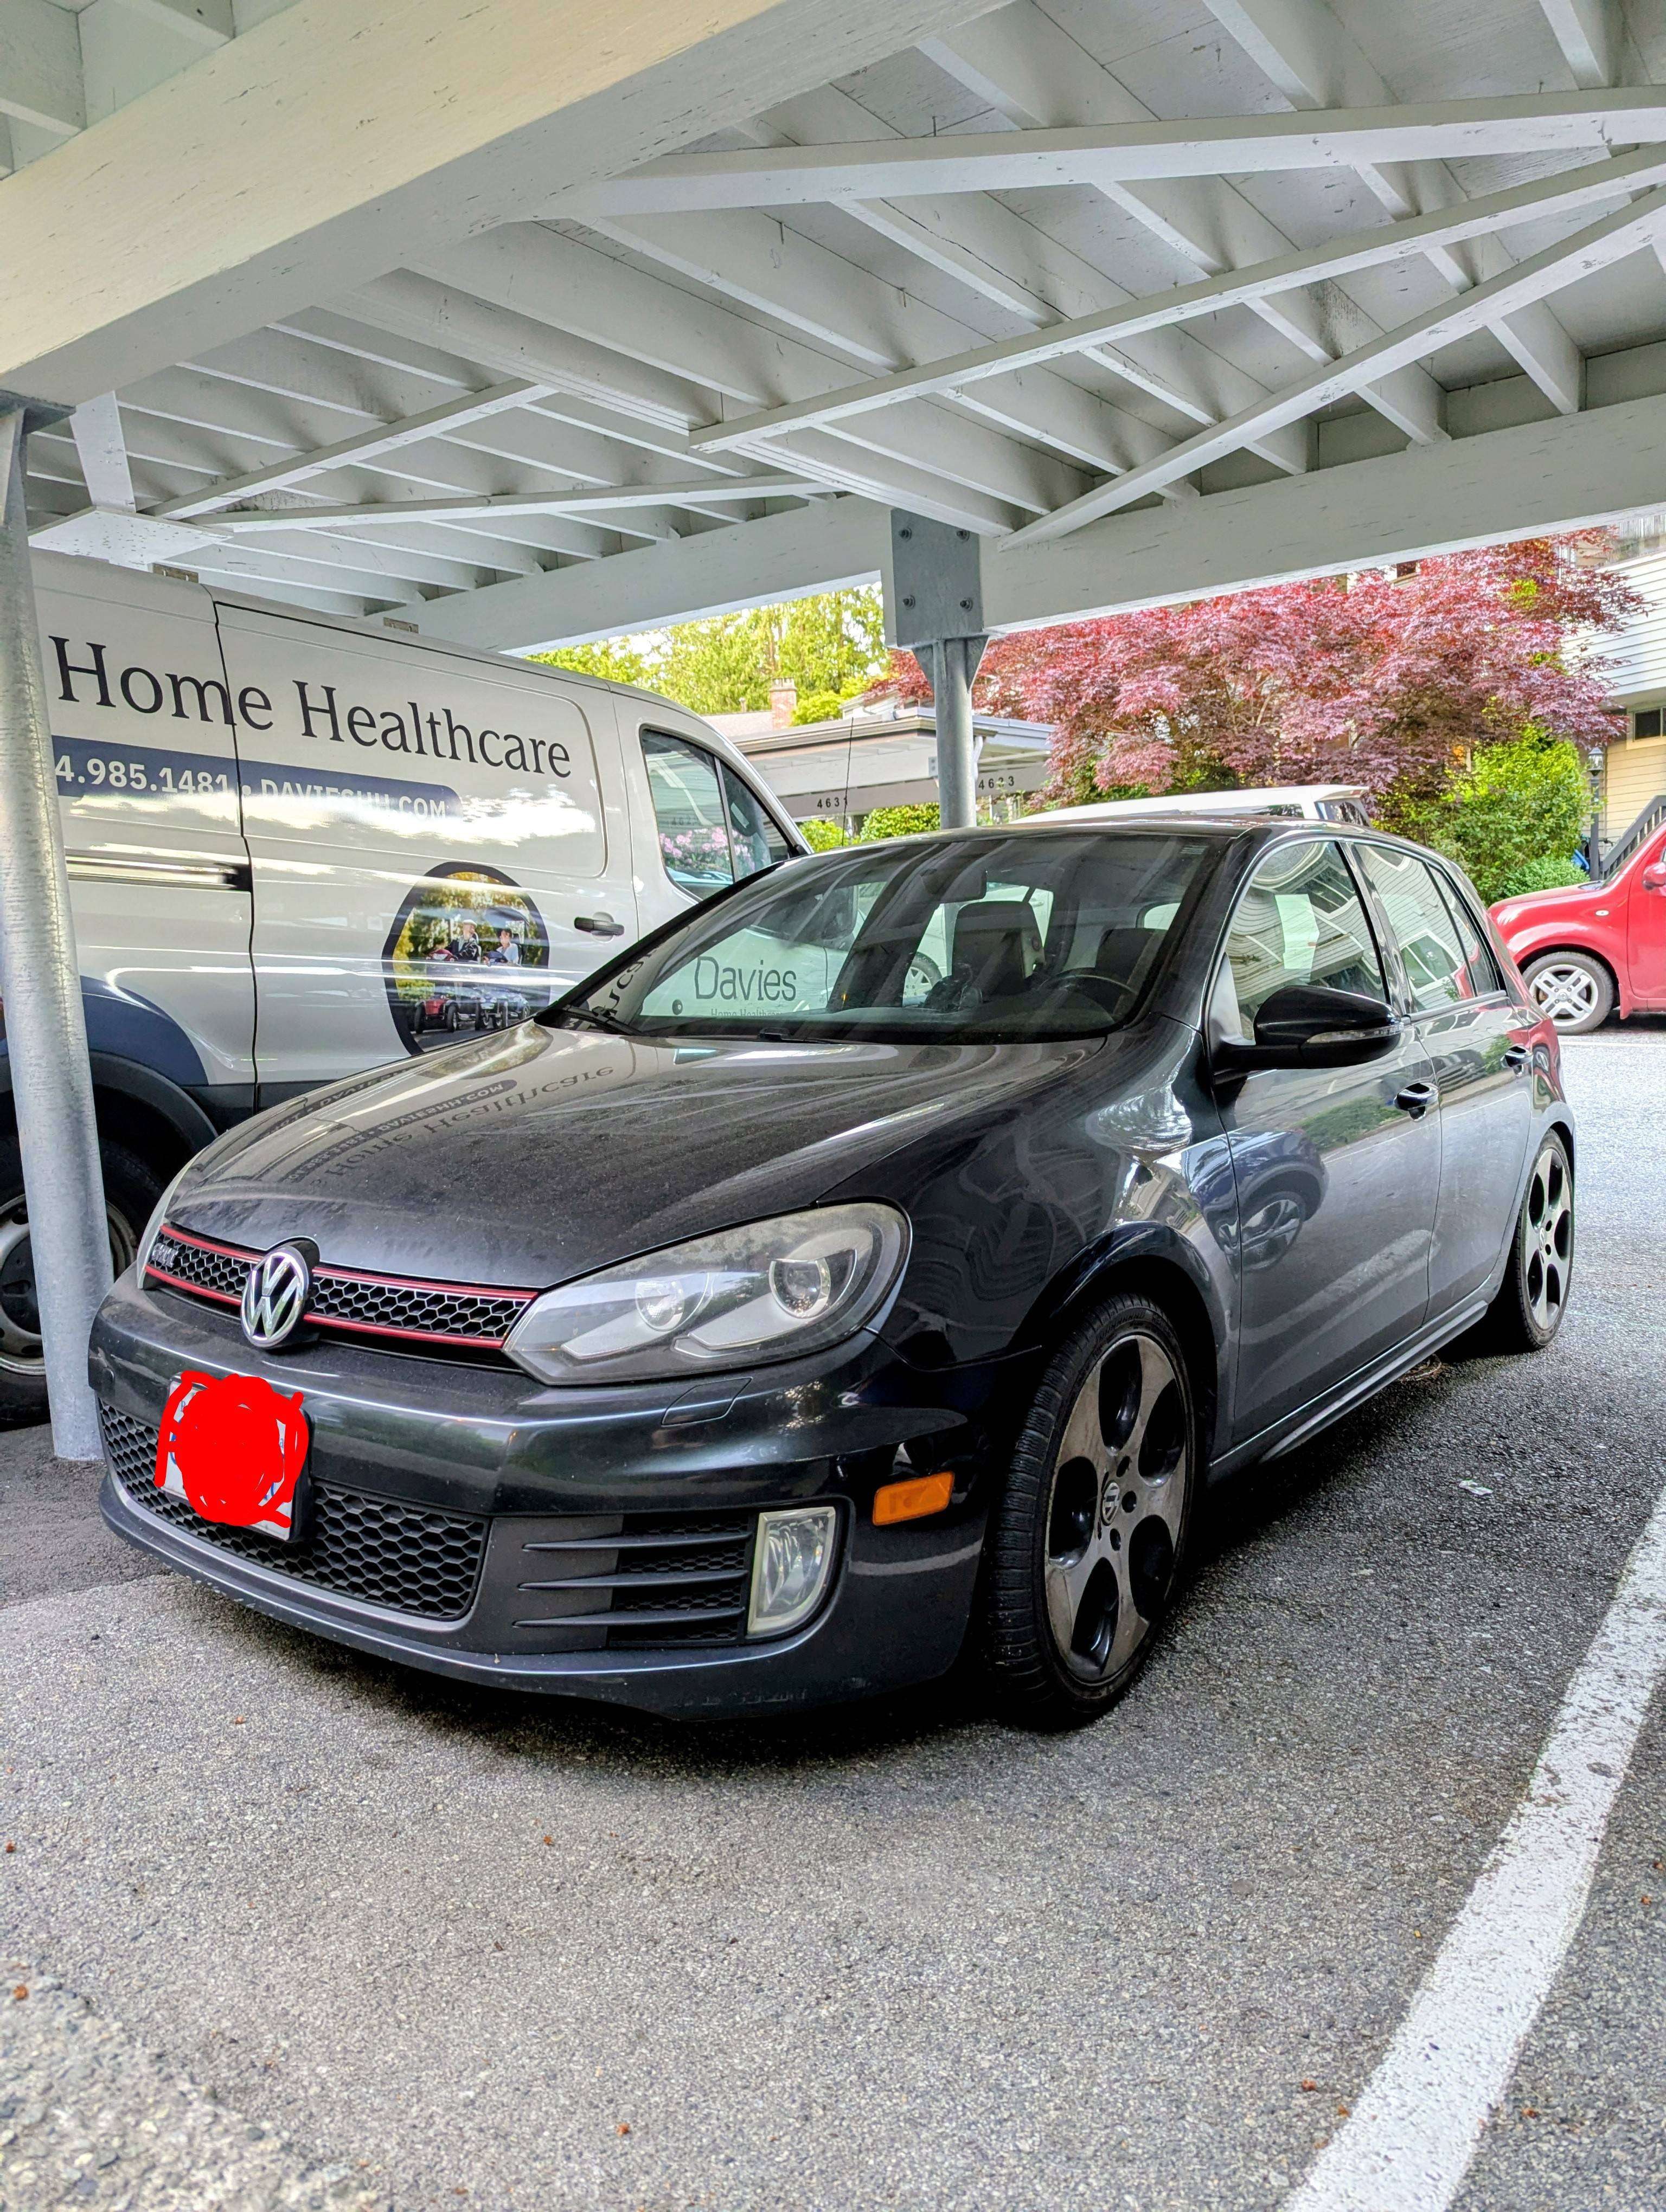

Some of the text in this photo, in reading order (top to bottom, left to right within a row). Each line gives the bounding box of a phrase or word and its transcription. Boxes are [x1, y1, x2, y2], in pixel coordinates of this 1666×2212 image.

[48, 635, 572, 778] Home Healthcare
[260, 779, 446, 820] DAVIHHCOM
[694, 956, 797, 1001] Davies
[740, 1009, 781, 1017] Healthca
